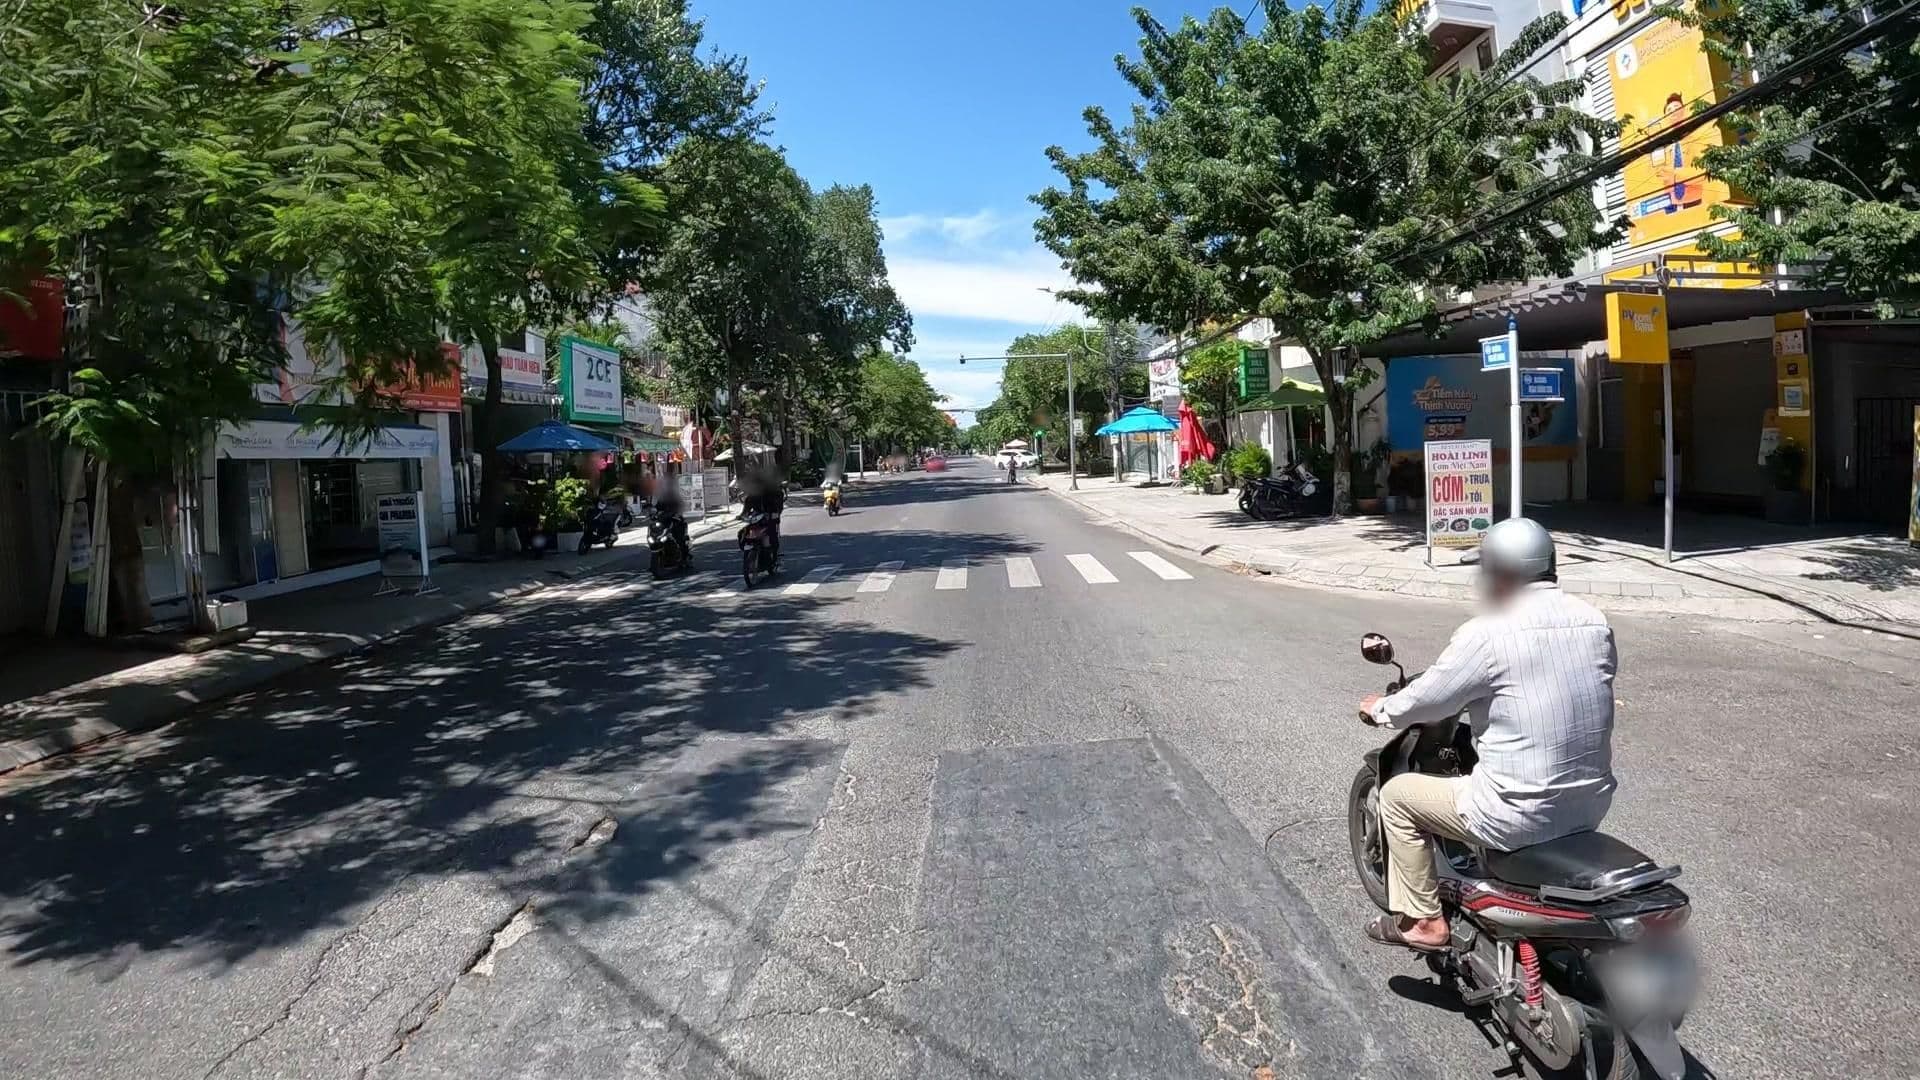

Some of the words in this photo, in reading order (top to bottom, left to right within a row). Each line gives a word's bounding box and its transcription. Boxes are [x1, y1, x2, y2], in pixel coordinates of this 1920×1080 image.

[1462, 451, 1488, 460] LINH
[1432, 473, 1464, 503] CƠM
[1479, 506, 1489, 514] AN
